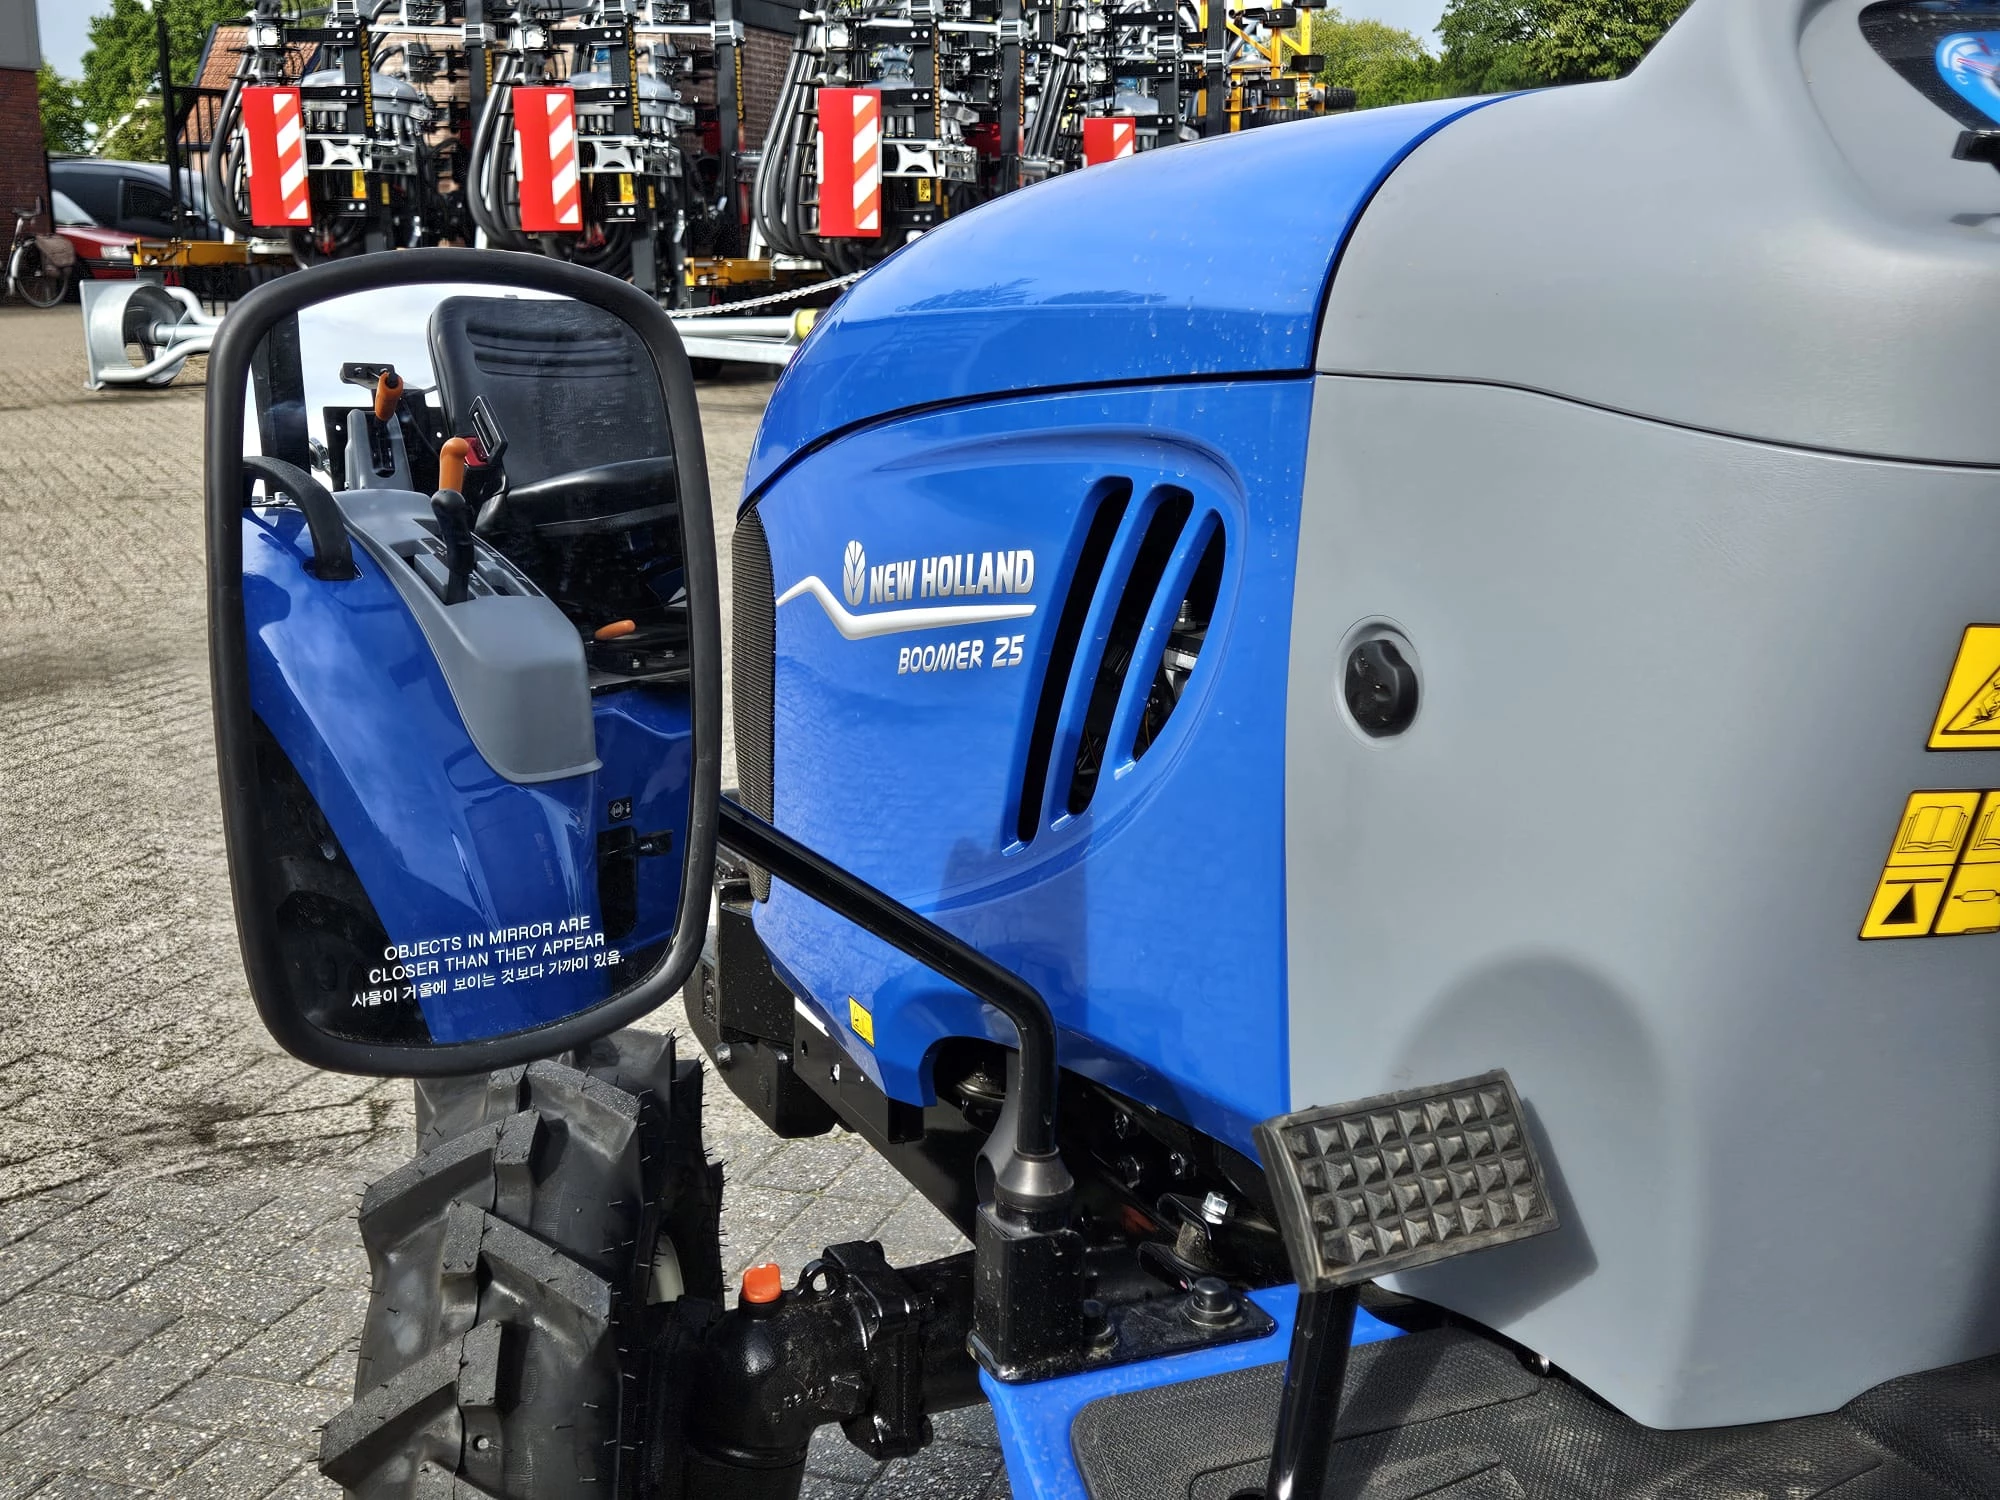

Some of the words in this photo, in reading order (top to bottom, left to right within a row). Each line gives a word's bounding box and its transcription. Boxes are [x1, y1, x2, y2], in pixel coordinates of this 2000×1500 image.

[869, 560, 917, 604] NEW
[921, 549, 1035, 597] HOLLAND
[897, 639, 985, 675] BOOMER
[992, 634, 1026, 668] 25
[369, 960, 440, 984] CLOSER
[445, 951, 489, 972] THAN
[497, 944, 537, 965] THEY
[542, 933, 605, 956] APPEAR
[384, 936, 462, 961] OBJECTS
[468, 932, 484, 948] IN
[489, 922, 553, 945] MIRROR
[558, 915, 591, 933] ARE
[352, 988, 398, 1008] 사물이
[402, 979, 447, 1000] 거울에
[452, 974, 497, 992] 보이는
[501, 966, 545, 985] 것보다
[548, 957, 589, 976] 가까이
[594, 949, 626, 969] 있음.
